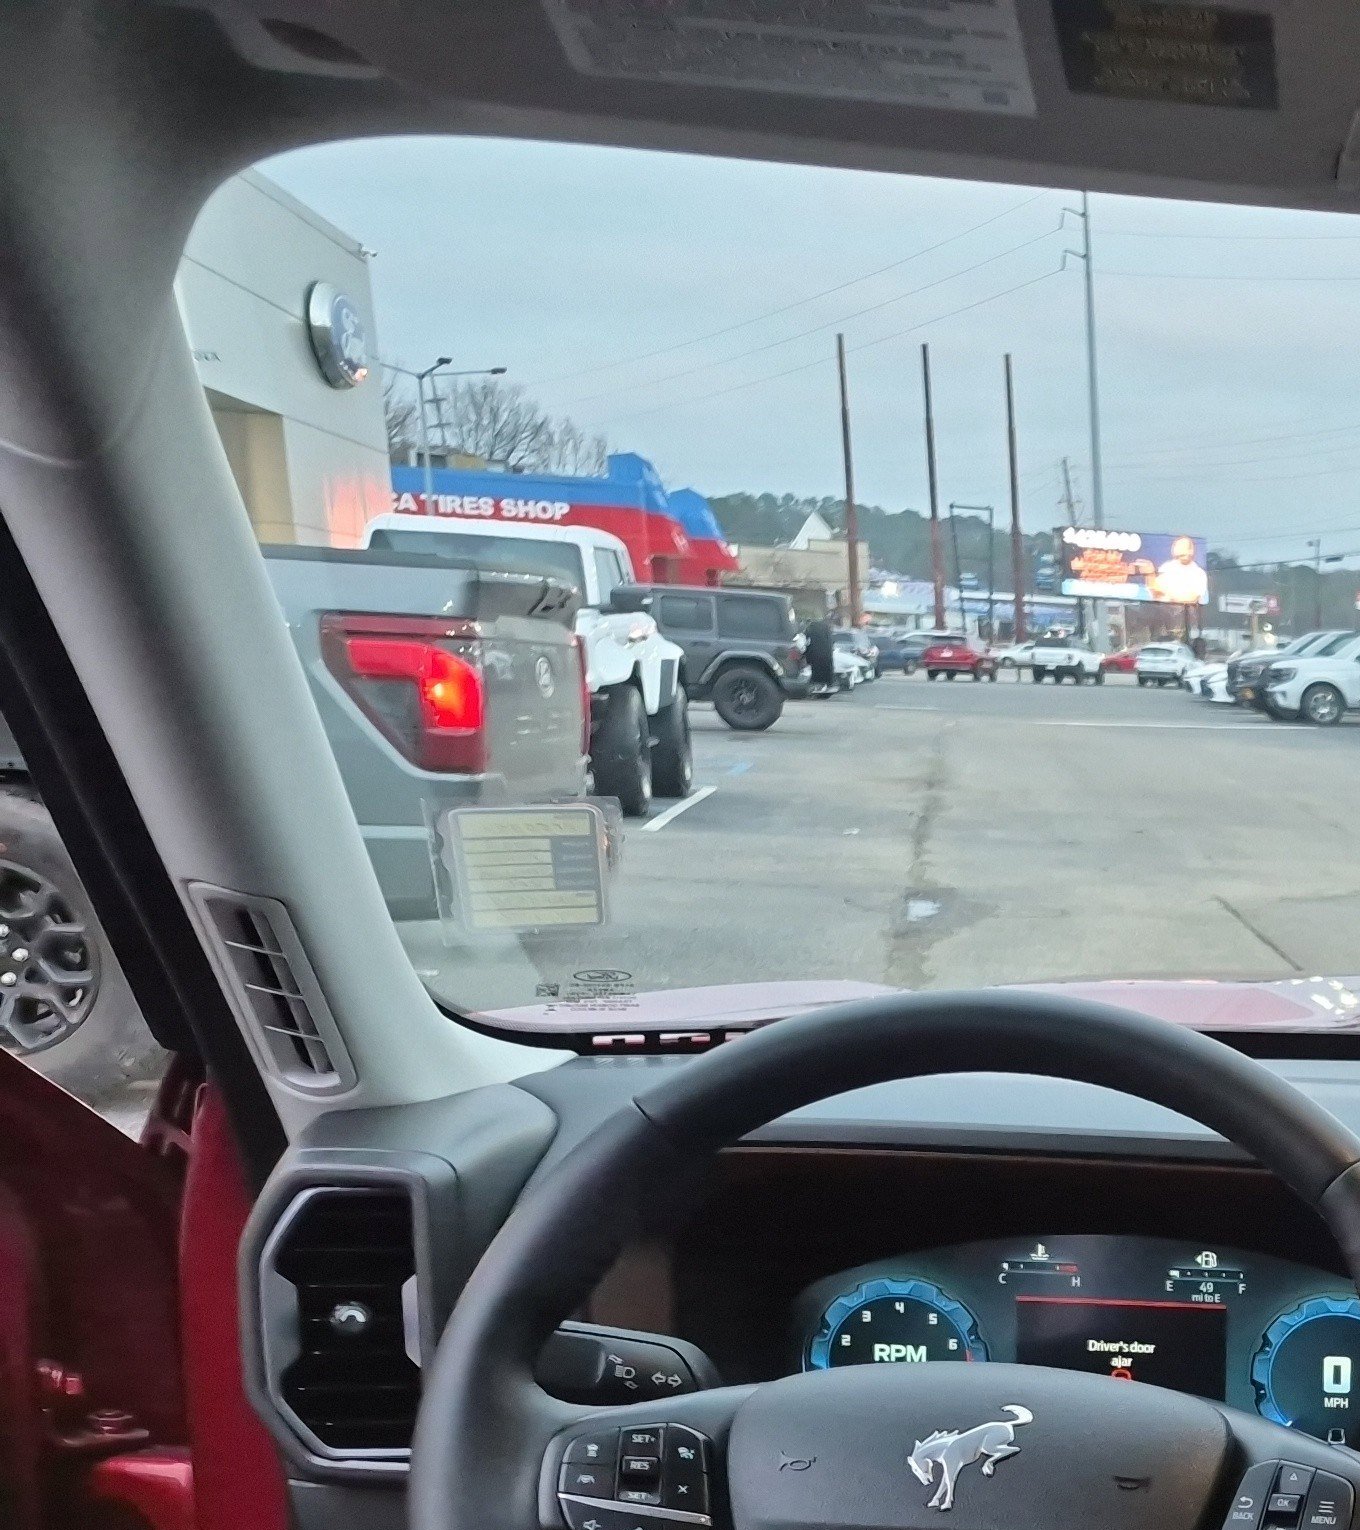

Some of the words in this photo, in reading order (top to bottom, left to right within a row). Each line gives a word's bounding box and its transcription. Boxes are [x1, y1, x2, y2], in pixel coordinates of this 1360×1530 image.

[420, 494, 495, 516] TIRES
[500, 498, 571, 520] SHOP
[998, 1273, 1007, 1285] C
[1071, 1276, 1081, 1288] H
[1165, 1281, 1174, 1293] E
[1199, 1282, 1214, 1293] 49
[1238, 1283, 1246, 1295] F
[1191, 1293, 1203, 1303] mi
[1204, 1293, 1213, 1303] to
[1214, 1294, 1221, 1303] E
[895, 1301, 905, 1313] 4
[862, 1310, 871, 1322] 3
[928, 1312, 938, 1325] 5
[841, 1334, 851, 1346] 2
[948, 1339, 958, 1350] 6
[873, 1343, 927, 1362] RPM
[1087, 1339, 1129, 1352] Driver's
[1129, 1341, 1156, 1354] door
[1110, 1356, 1133, 1369] ajar
[1323, 1355, 1351, 1394] 0
[1324, 1397, 1349, 1409] MPH
[629, 1461, 650, 1471] RES
[1277, 1499, 1290, 1507] OK
[1232, 1511, 1254, 1521] BACK
[1310, 1515, 1337, 1525] MENU
